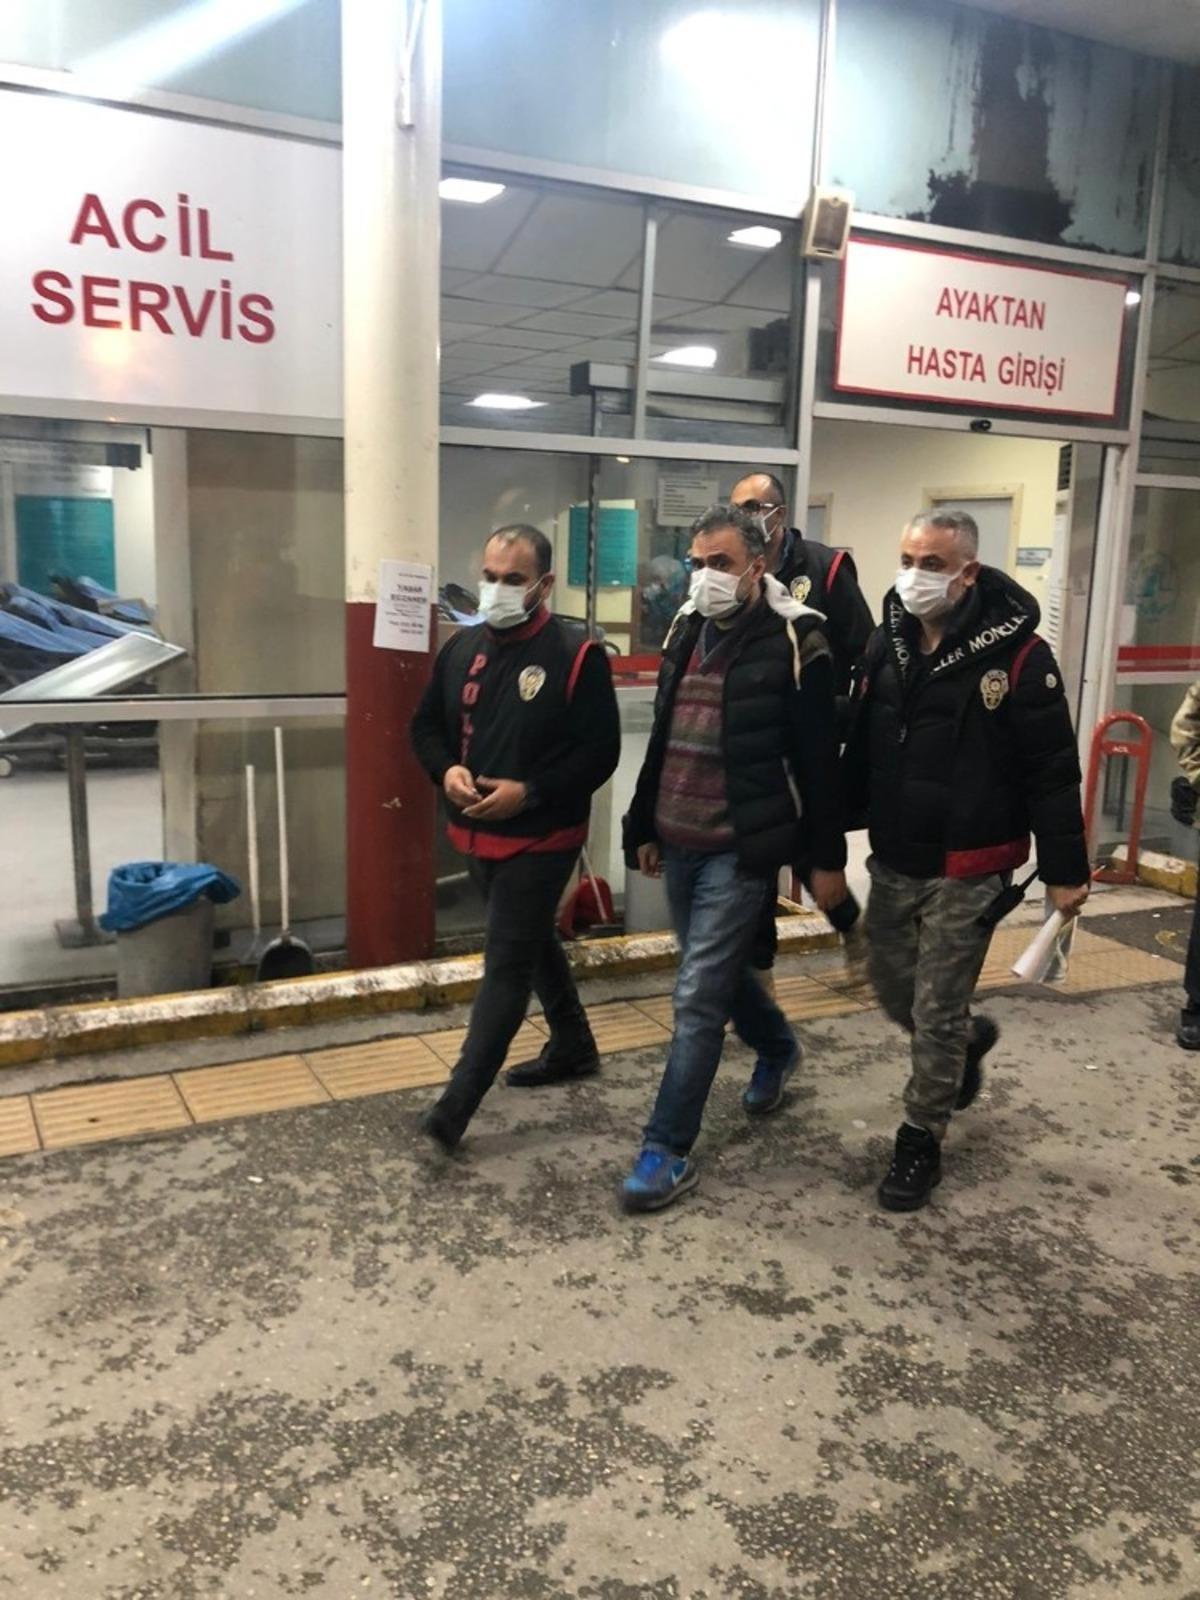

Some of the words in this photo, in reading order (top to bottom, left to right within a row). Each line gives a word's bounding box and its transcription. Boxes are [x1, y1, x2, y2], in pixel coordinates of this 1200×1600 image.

[69, 193, 234, 262] ACİL
[31, 270, 275, 344] SERVİS
[936, 287, 1046, 330] AYAKTAN
[907, 345, 986, 383] HASTA
[998, 352, 1065, 396] GİRİŞİ
